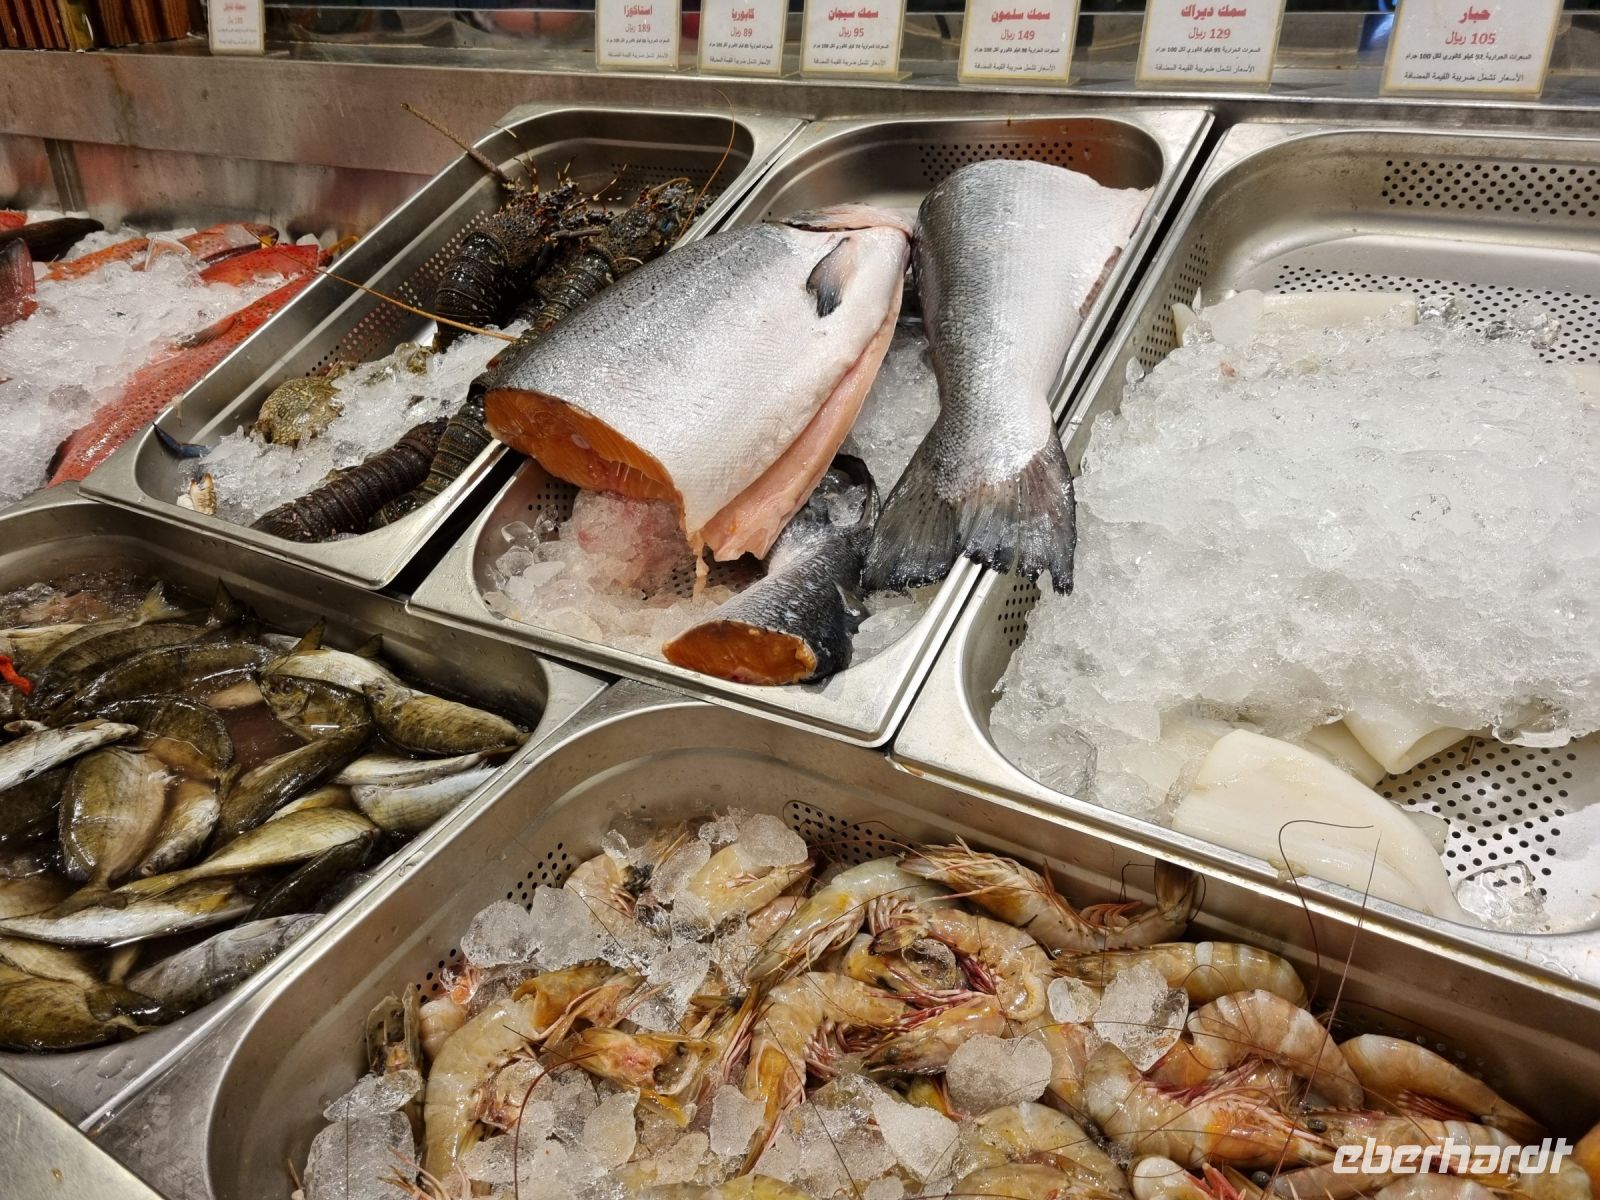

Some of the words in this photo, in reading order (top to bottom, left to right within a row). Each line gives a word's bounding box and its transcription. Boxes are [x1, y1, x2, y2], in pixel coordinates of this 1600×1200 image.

[858, 7, 879, 18] سمك
[991, 8, 1024, 22] سلمون
[1027, 8, 1050, 20] سمك
[1181, 4, 1214, 20] ديراك
[1218, 5, 1246, 18] سمك
[1458, 6, 1491, 24] حبار
[638, 24, 651, 32] 189
[743, 28, 753, 37] 89
[838, 27, 852, 37] ريال
[854, 27, 864, 37] 95
[1188, 27, 1206, 40] ريال
[1209, 28, 1231, 39] 129
[1000, 29, 1015, 40] ريال
[1018, 30, 1036, 40] 149
[1445, 31, 1466, 45] ريال
[1470, 32, 1496, 45] 105
[1403, 71, 1430, 80] المضافة
[1432, 72, 1450, 81] القيمة
[1452, 72, 1476, 82] ضريبة
[1477, 73, 1496, 82] تشمل
[1498, 72, 1524, 83] الأسعار
